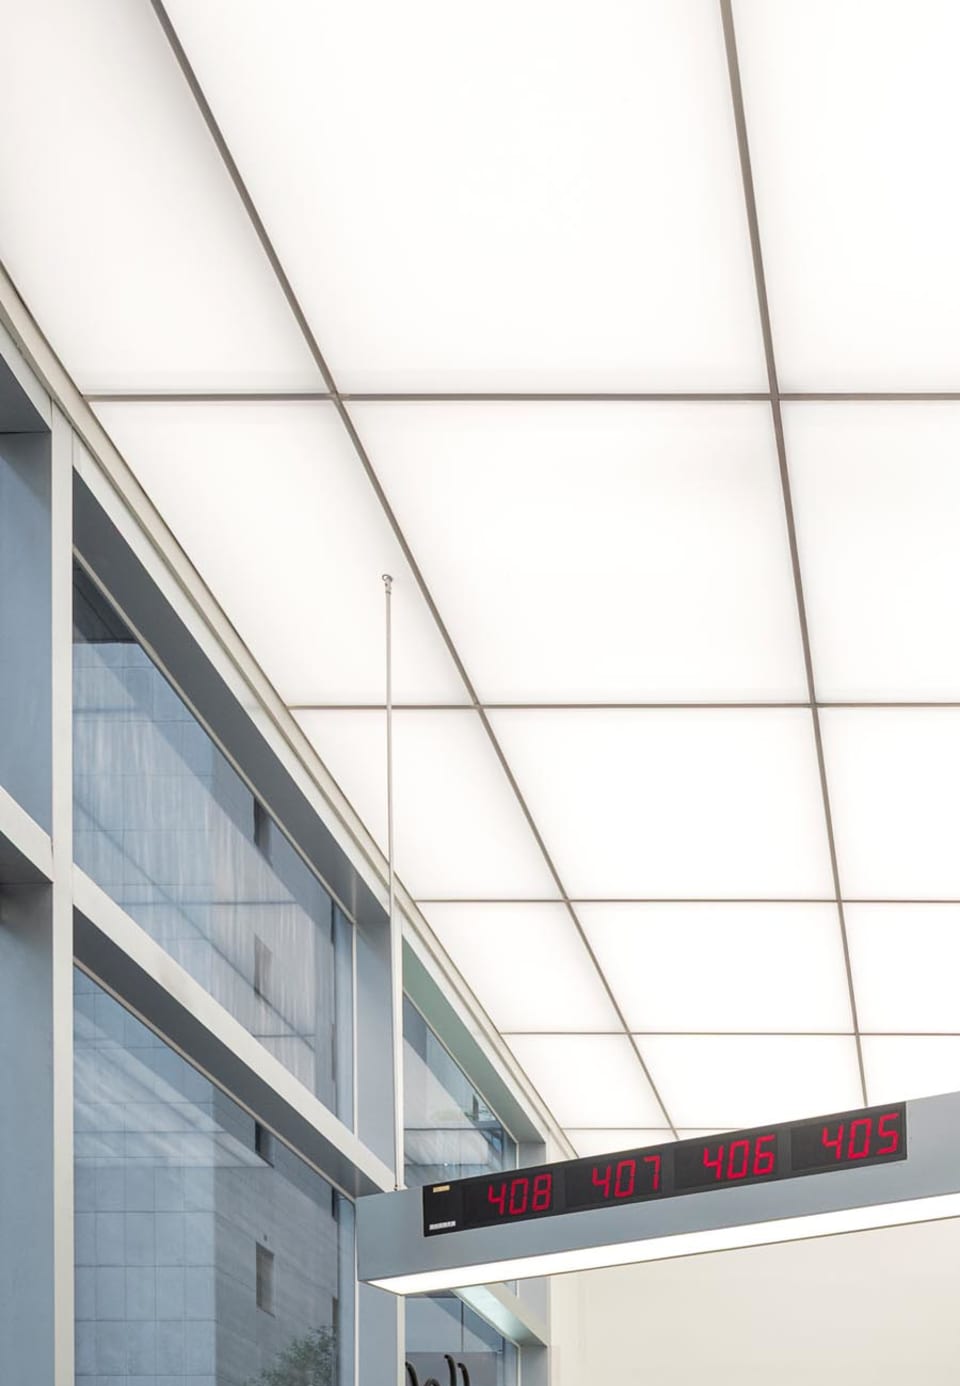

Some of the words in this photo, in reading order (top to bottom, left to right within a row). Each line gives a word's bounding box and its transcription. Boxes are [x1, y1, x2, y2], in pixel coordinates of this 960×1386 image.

[488, 1173, 552, 1215] 408
[592, 1155, 661, 1198] 407
[702, 1134, 775, 1180] 406
[822, 1112, 899, 1160] 405
